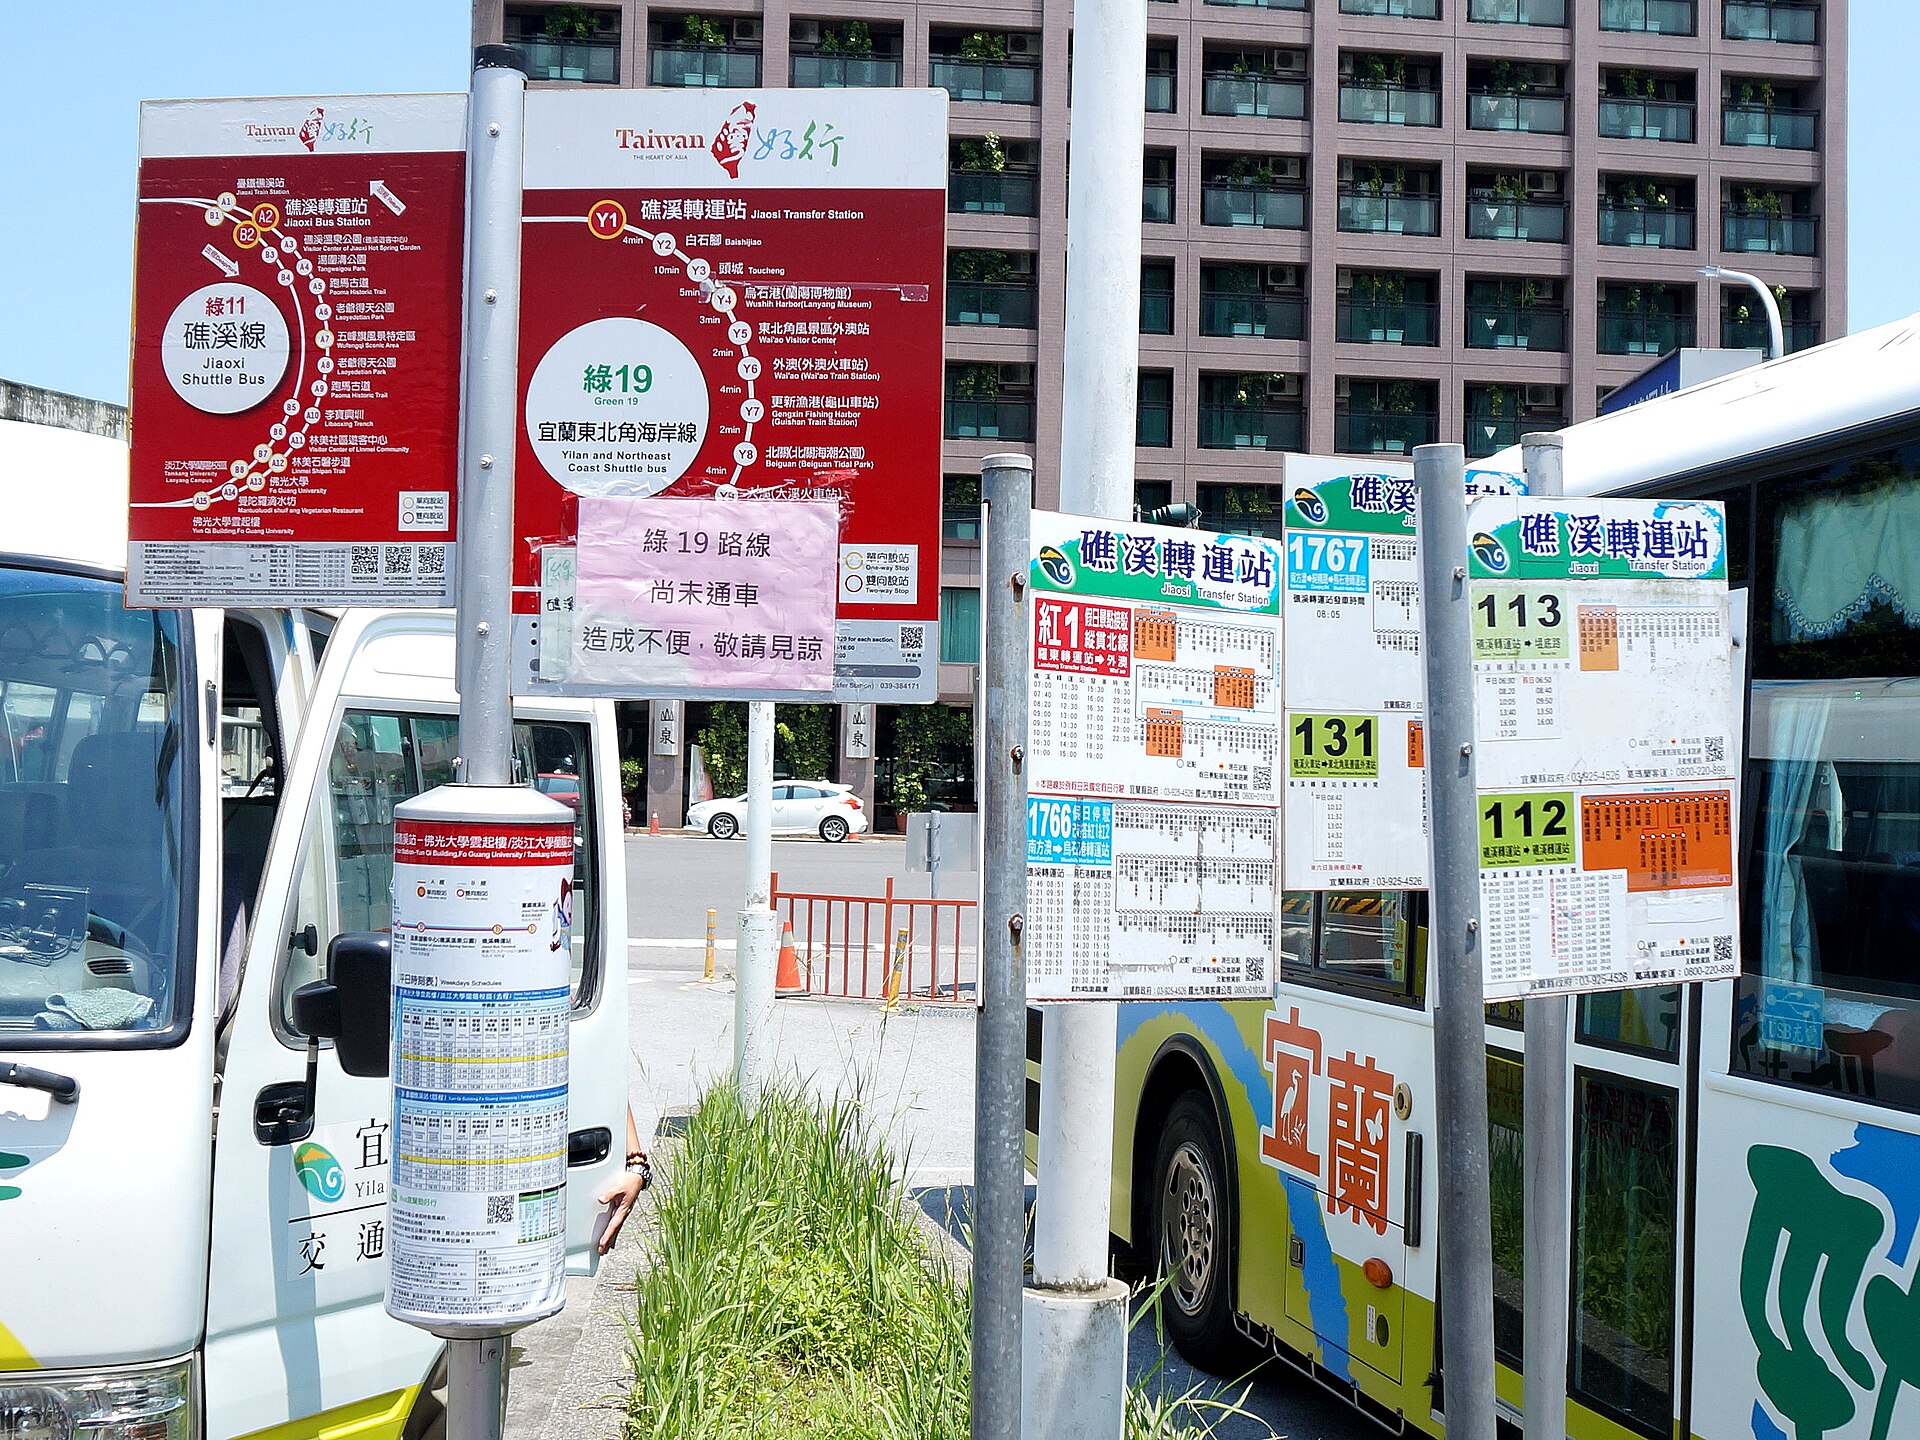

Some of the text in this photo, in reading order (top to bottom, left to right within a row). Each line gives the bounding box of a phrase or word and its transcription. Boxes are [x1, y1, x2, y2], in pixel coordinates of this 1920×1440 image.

[245, 125, 295, 136] Taiwan
[615, 129, 704, 149] Taiwan
[754, 119, 844, 168] 好行
[221, 197, 230, 205] A1
[285, 199, 367, 215] 礁溪轉運站
[641, 199, 746, 221] 礁溪轉運站
[751, 209, 863, 220] Jiaosi Transfer Station
[259, 210, 272, 223] A2
[284, 218, 370, 227] Jiaoxi Bus Station
[596, 212, 618, 228] Y1
[240, 228, 254, 241] B2
[623, 236, 643, 245] 4min
[686, 234, 722, 247] 白石腳
[657, 239, 672, 250] Y2
[725, 238, 762, 247] Baishijiao
[654, 266, 679, 274] 10min
[692, 265, 706, 276] Y3
[719, 262, 743, 275] 頭城
[748, 266, 785, 276] Toucheng
[679, 288, 700, 297] 5min
[717, 294, 731, 305] Y4
[837, 301, 872, 309] Museum)
[206, 297, 245, 316] 綠11
[700, 316, 720, 324] 3min
[734, 329, 747, 338] Y5
[759, 322, 869, 335] 東北角風景區外澳站
[184, 322, 266, 350] 礁溪線
[320, 335, 330, 343] A7
[713, 348, 733, 356] 2min
[203, 357, 244, 369] Jiaoxi
[744, 364, 757, 373] Y6
[773, 358, 868, 371] 外澳(外澳火車站)
[182, 374, 265, 385] Shuttle Bus
[583, 364, 652, 394] 綠19
[594, 397, 638, 406] Green 19
[745, 407, 759, 416] Y7
[805, 411, 833, 419] Fishing
[537, 421, 697, 444] 宜蘭東北角海岸線
[719, 426, 740, 434] 2min
[562, 451, 671, 460] Yilan and Northeast
[739, 451, 753, 459] Y8
[568, 463, 667, 473] Coast Shuttle bus
[854, 460, 874, 468] Park)
[270, 477, 308, 486] 佛光大學
[1351, 476, 1415, 513] 礁溪
[1403, 517, 1416, 526] Jia
[1521, 513, 1708, 559] 礁溪轉運站
[643, 530, 771, 558] 綠 19 路線
[1081, 530, 1272, 588] 礁溪轉運站
[1290, 536, 1364, 572] 1767
[1569, 560, 1706, 574] Jiaoxi Transfer Station
[866, 575, 908, 586] 雙向設站
[651, 580, 759, 607] 尚未通車
[1161, 584, 1269, 605] Jiaosi Transfer Station
[1317, 610, 1340, 618] 08:05
[1477, 594, 1561, 628] 113
[1038, 602, 1079, 648] 紅1
[582, 626, 823, 662] 造成不便，敬請見諒
[1084, 630, 1128, 652] 縱貫北線
[1295, 718, 1372, 756] 131
[1029, 802, 1072, 838] 1766
[1485, 800, 1567, 838] 112
[354, 1119, 388, 1169] 宜
[355, 1180, 384, 1198] Yila
